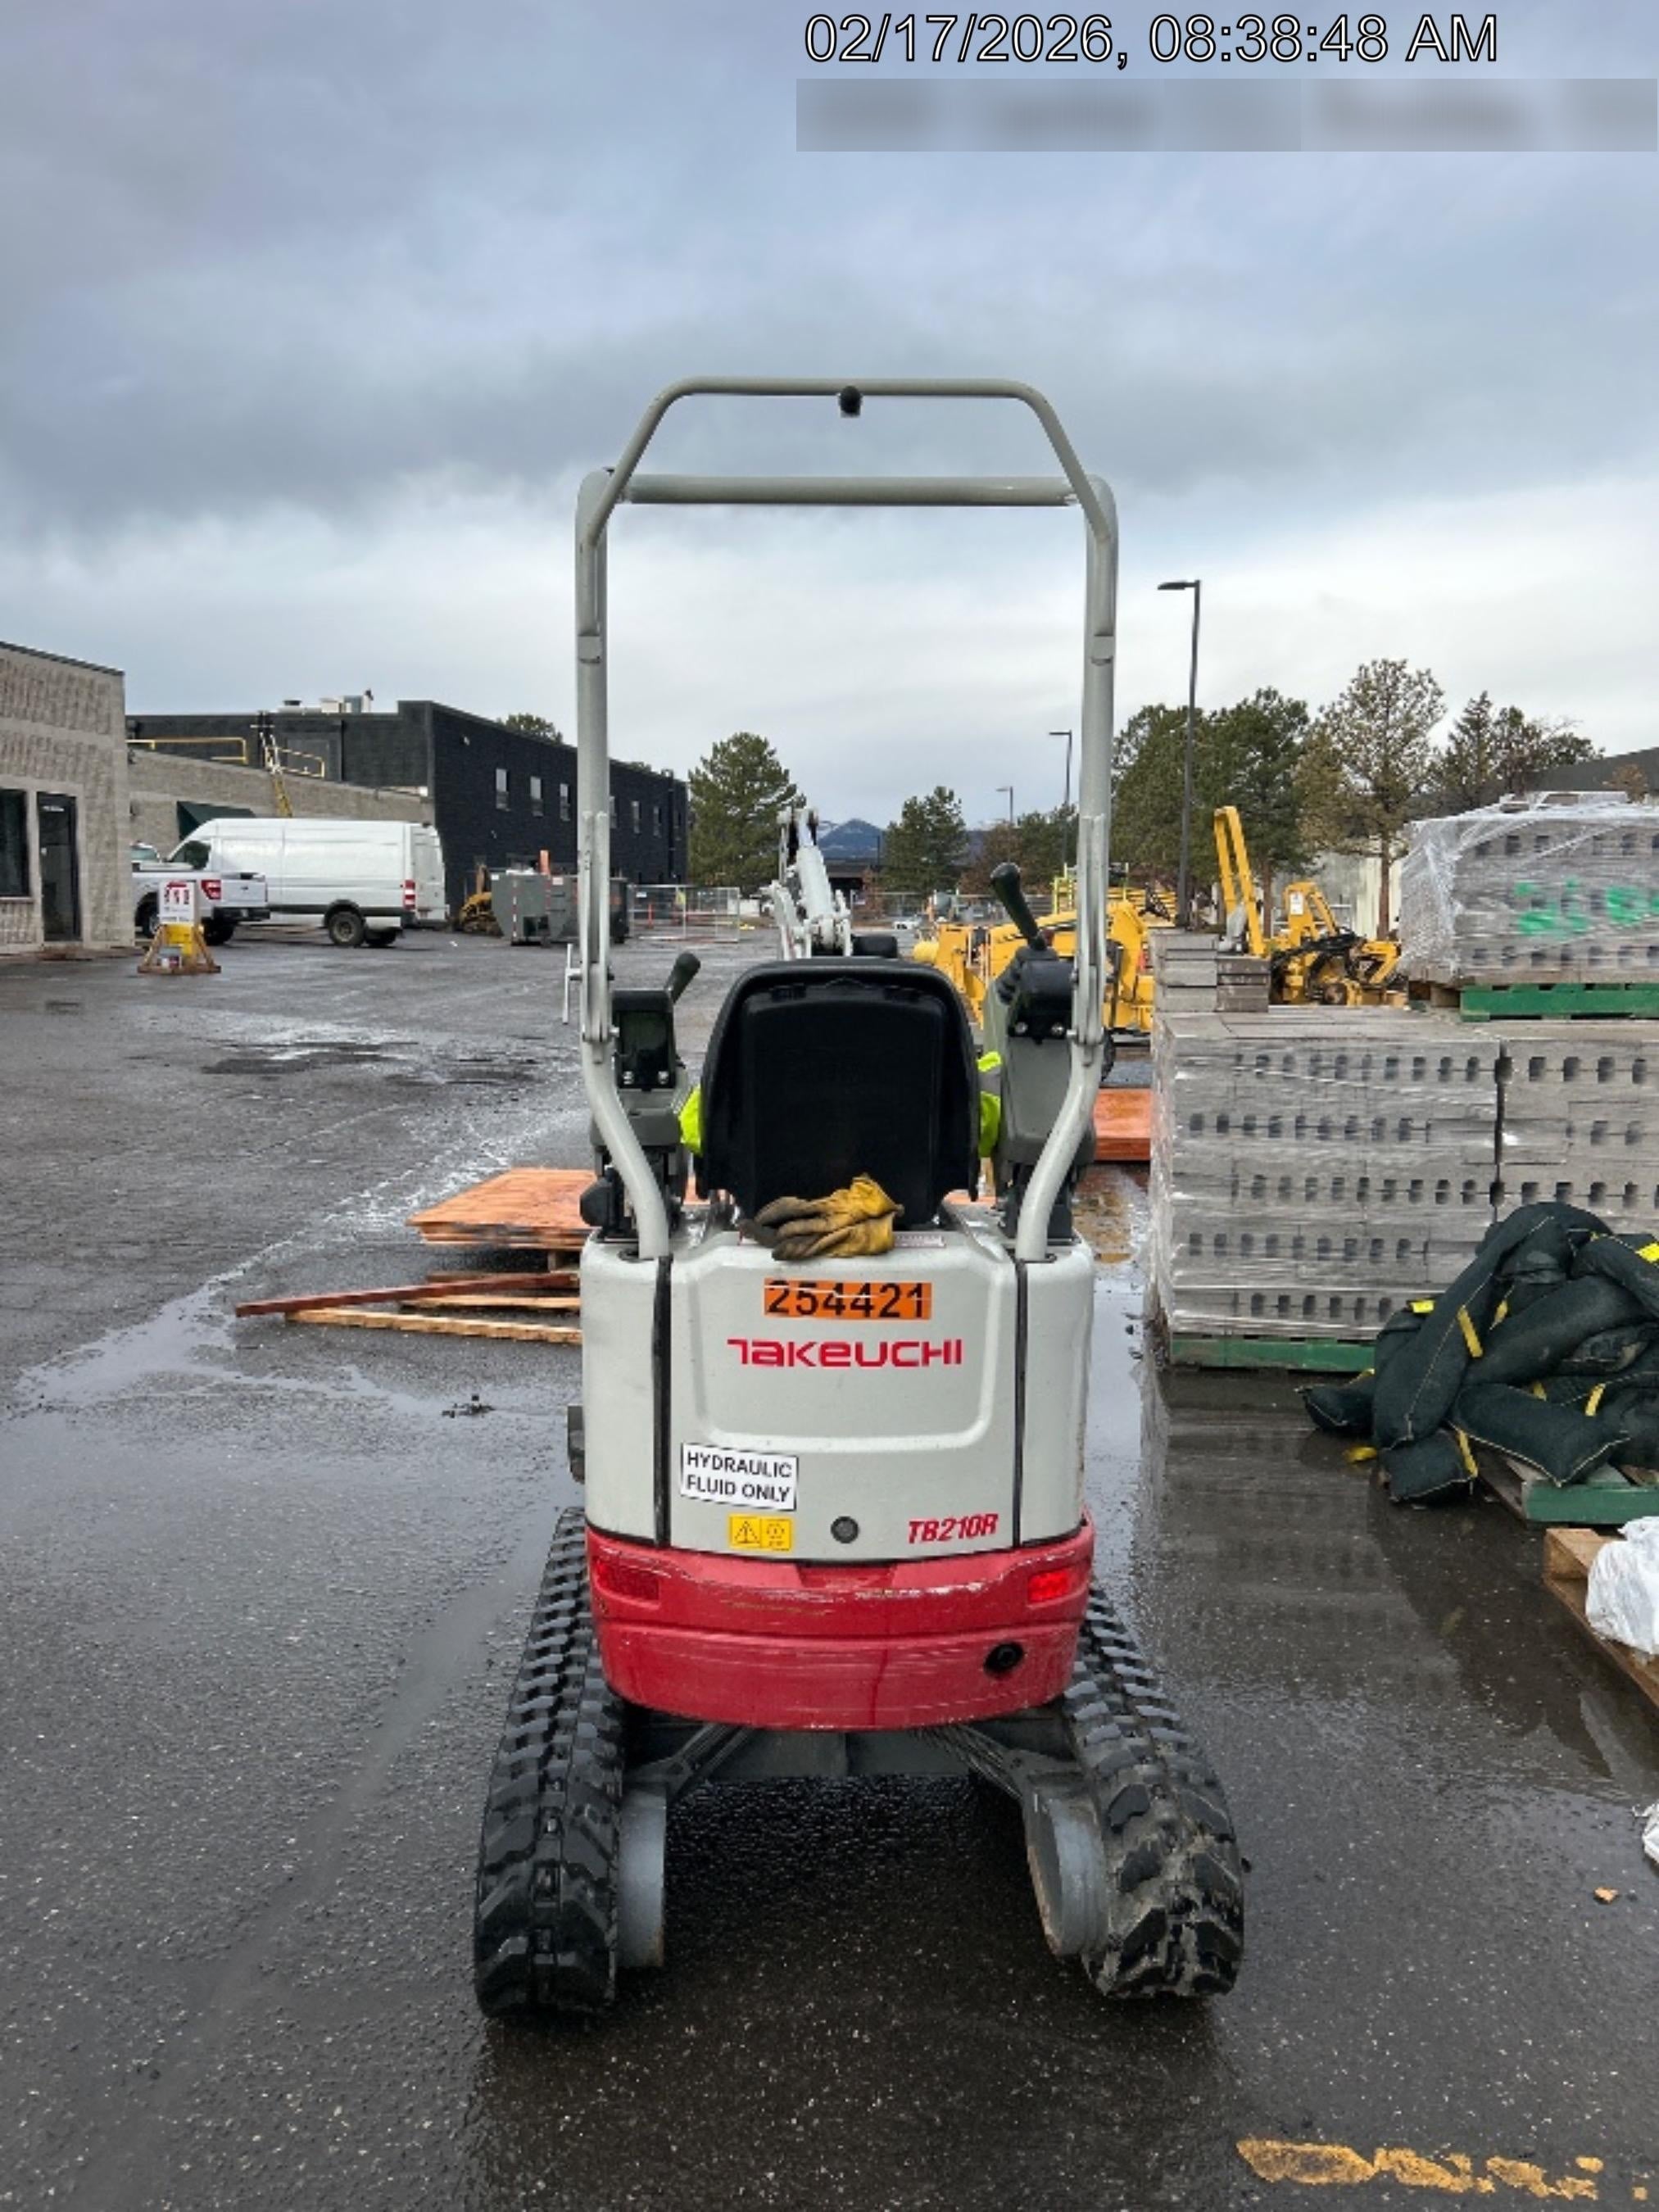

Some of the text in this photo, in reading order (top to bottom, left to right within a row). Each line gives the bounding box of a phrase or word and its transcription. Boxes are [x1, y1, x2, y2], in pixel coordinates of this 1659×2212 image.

[766, 1280, 922, 1318] 254421
[687, 1451, 792, 1478] HYDRAULIC
[687, 1473, 791, 1503] FLUID ONLY
[909, 1513, 999, 1544] TB210R
